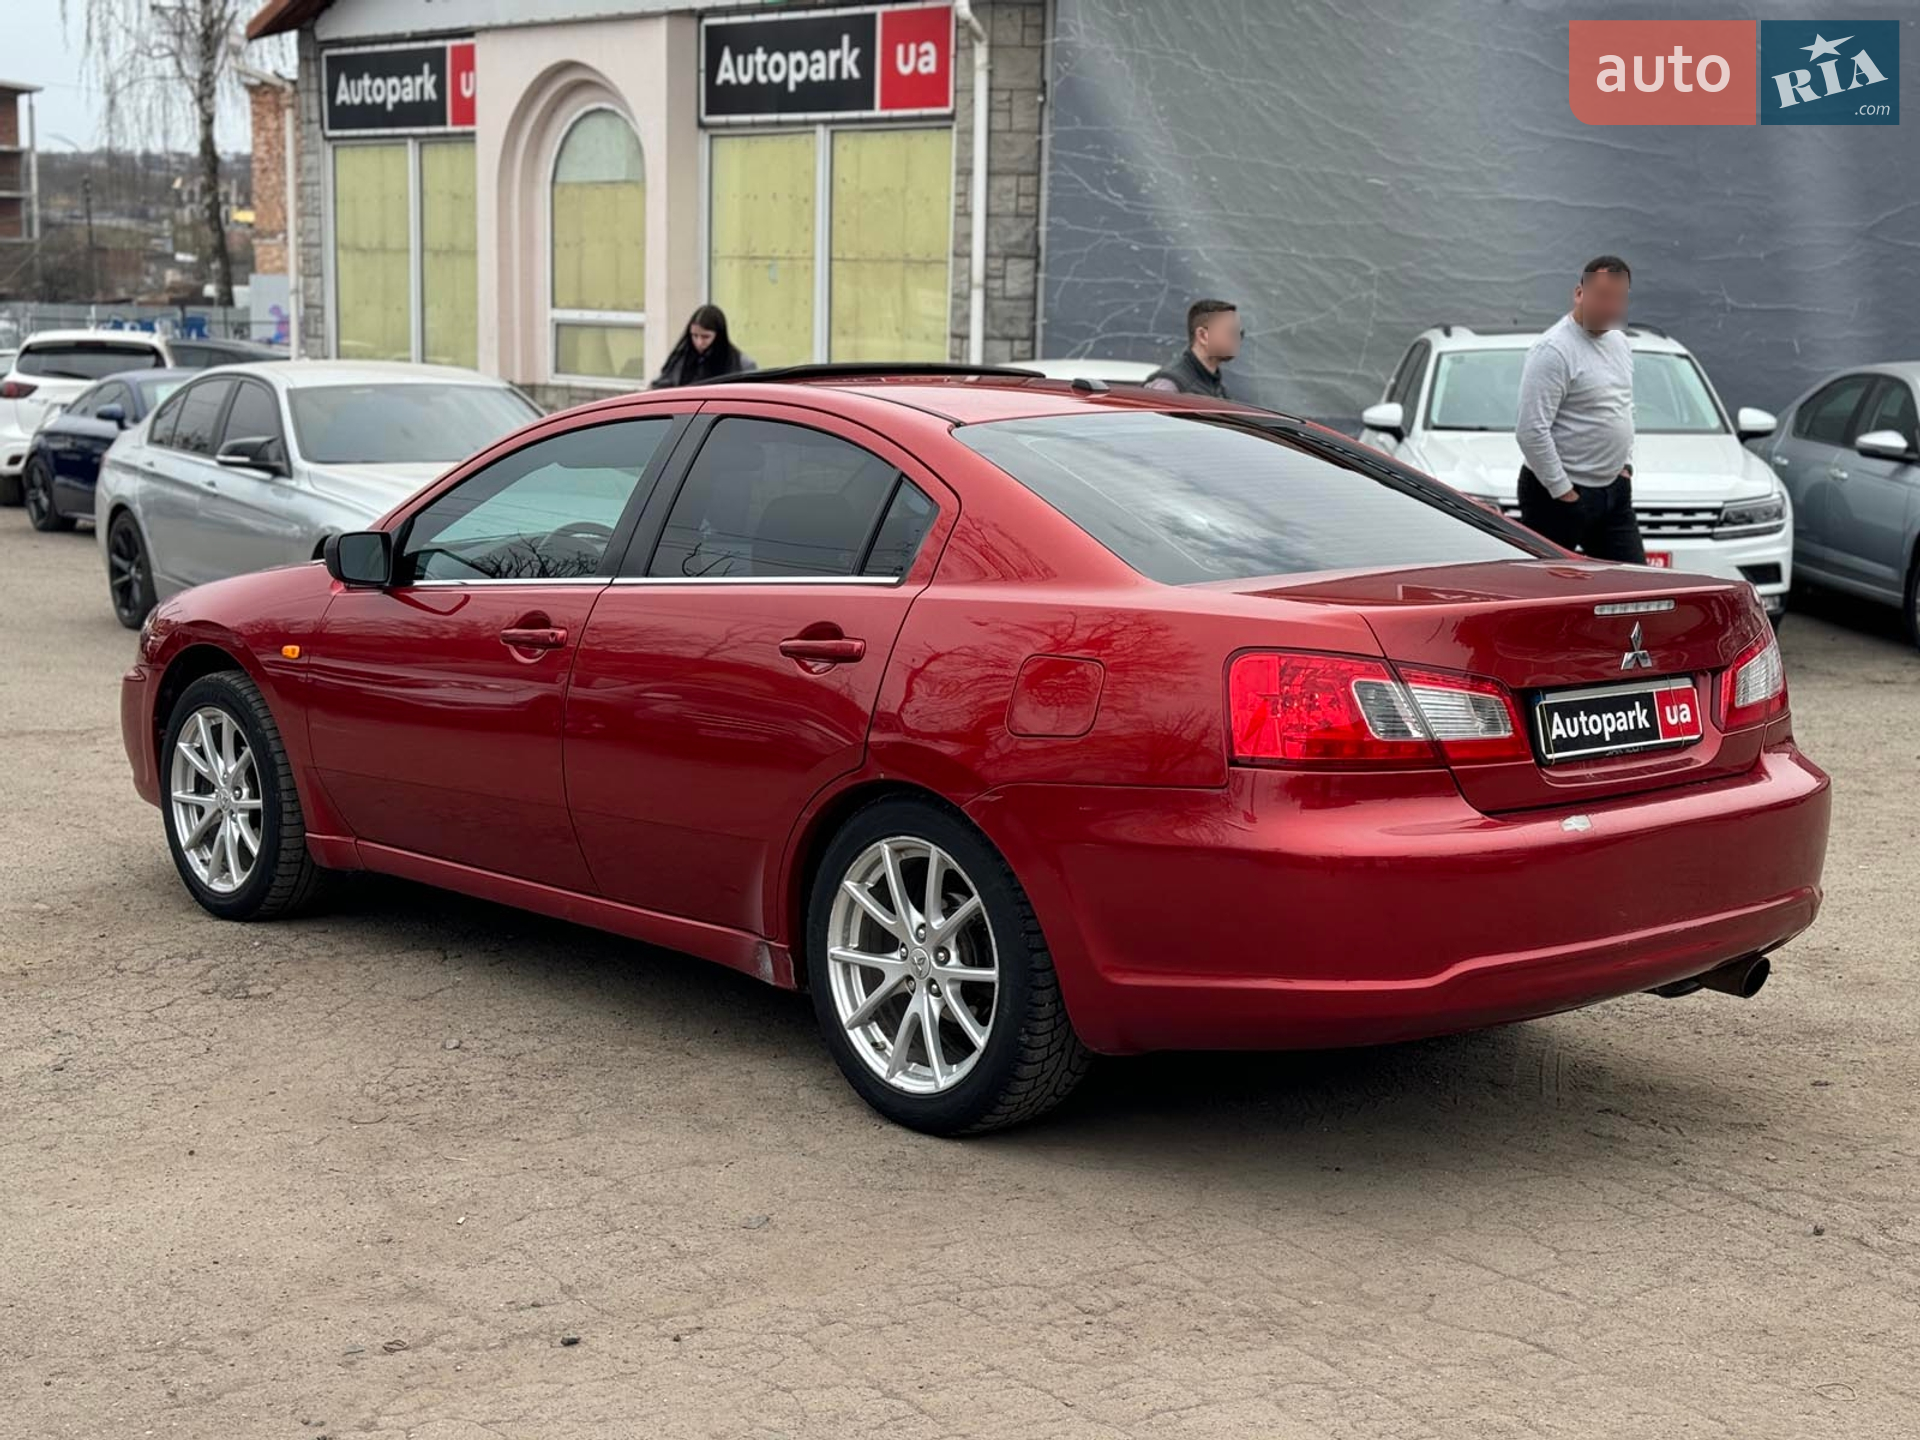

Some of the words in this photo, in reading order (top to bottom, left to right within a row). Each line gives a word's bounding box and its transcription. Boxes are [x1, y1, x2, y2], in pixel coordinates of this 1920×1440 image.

[335, 62, 437, 112] Autopark
[717, 34, 862, 92] Autopark
[895, 40, 937, 75] ua
[1551, 701, 1651, 742] Autopark
[1665, 702, 1692, 725] ua
